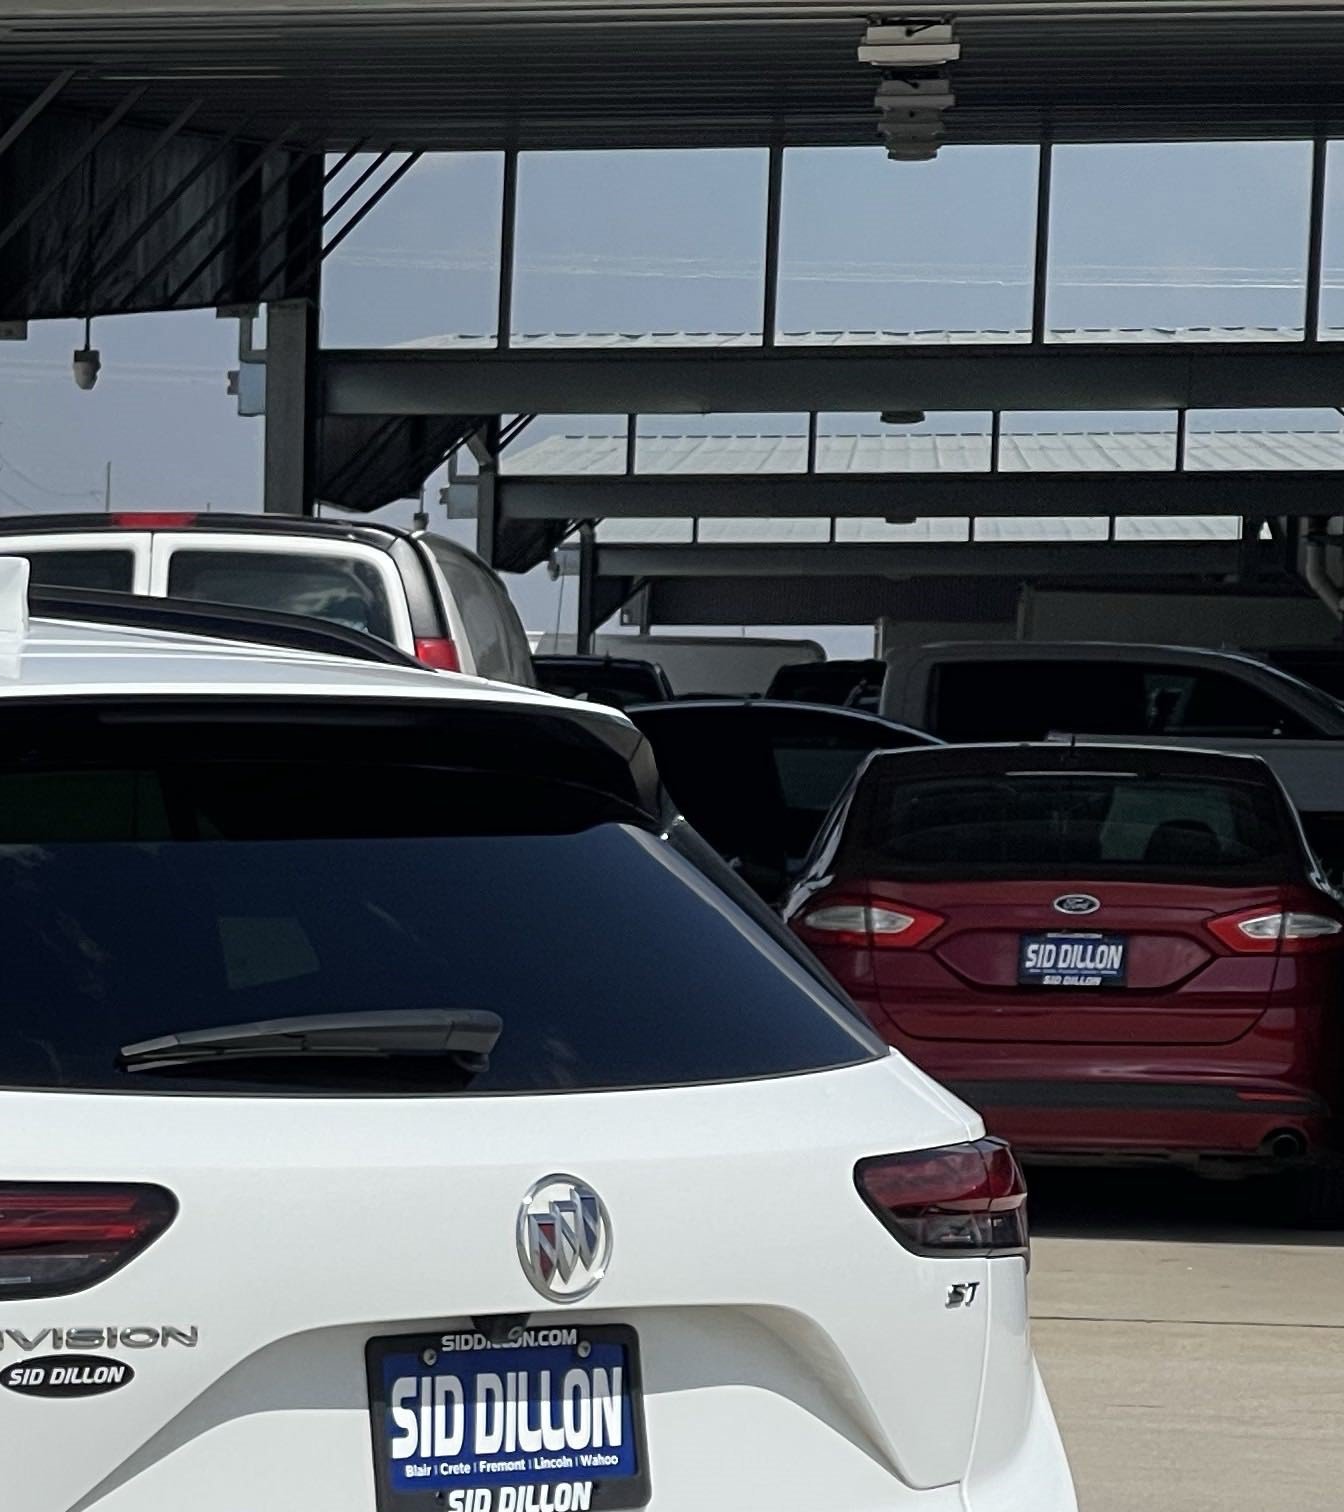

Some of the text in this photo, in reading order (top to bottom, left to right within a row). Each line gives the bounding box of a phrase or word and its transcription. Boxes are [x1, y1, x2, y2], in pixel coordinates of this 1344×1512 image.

[1025, 944, 1123, 969] SID DILLON
[8, 1366, 125, 1386] SID DILLON
[391, 1367, 622, 1459] SID DILLON
[405, 1454, 618, 1478] Blair Crete Fremont Lincoln Wahoo
